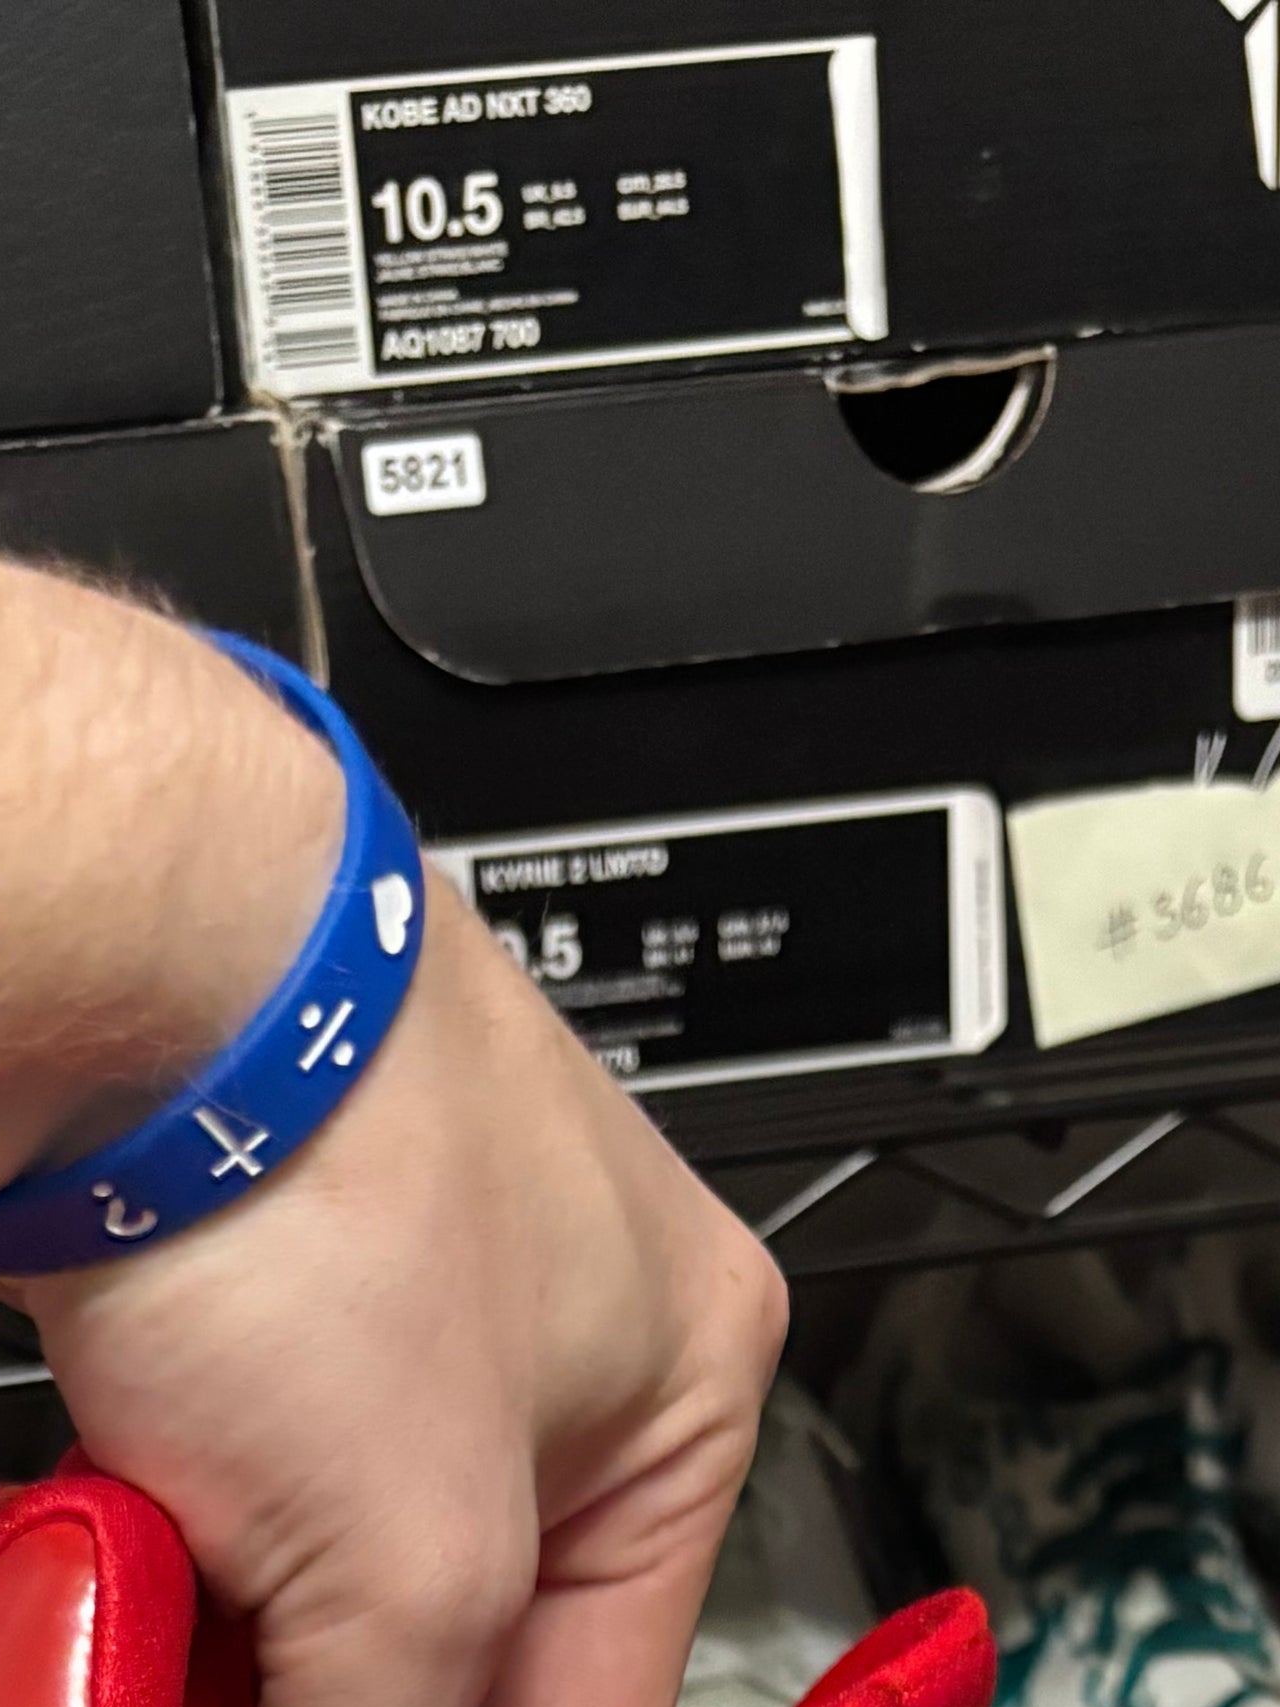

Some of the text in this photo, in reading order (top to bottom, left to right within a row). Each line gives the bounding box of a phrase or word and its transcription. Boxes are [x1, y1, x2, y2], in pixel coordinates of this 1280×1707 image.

[361, 96, 439, 130] KOBE
[442, 92, 482, 124] AD
[371, 172, 503, 243] 10.5
[380, 450, 467, 494] 5821
